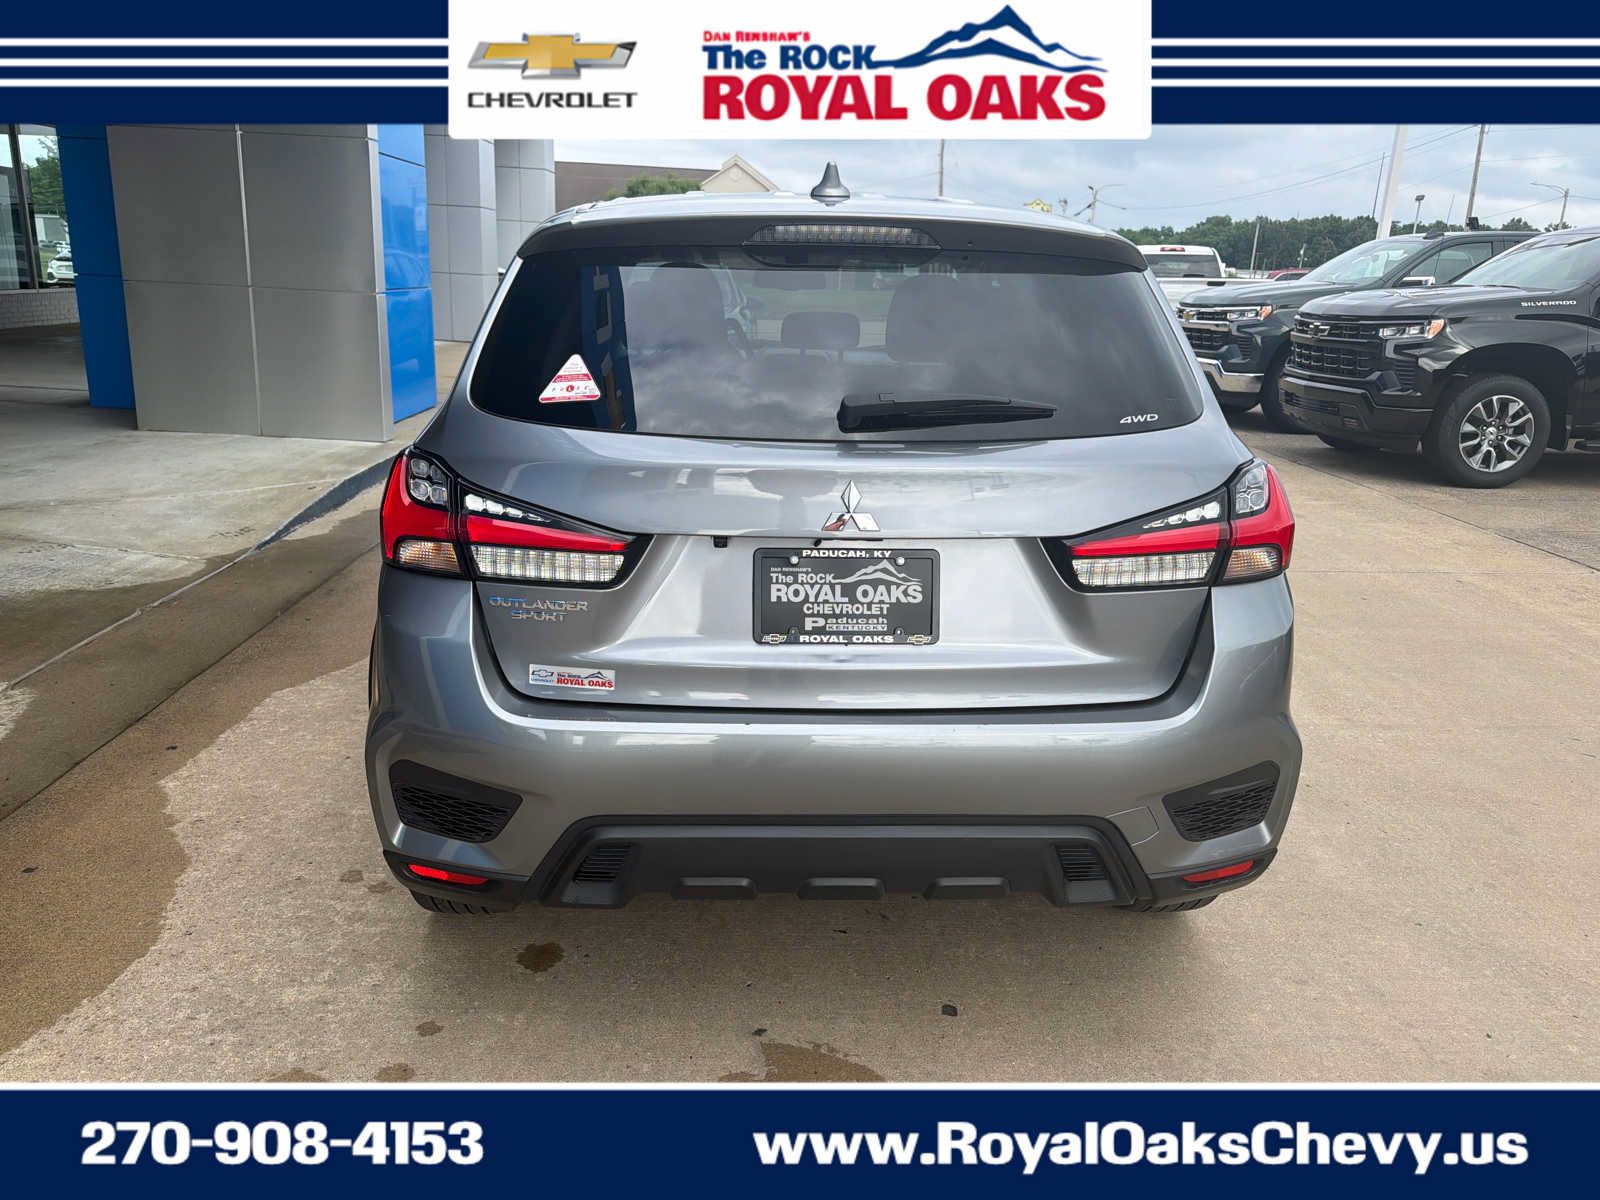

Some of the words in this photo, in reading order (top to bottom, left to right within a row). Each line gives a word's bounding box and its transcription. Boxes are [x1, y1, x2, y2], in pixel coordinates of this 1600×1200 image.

[1119, 413, 1159, 424] 4WD
[802, 550, 870, 559] PADUCAH,
[873, 550, 892, 558] KY
[770, 573, 794, 583] The
[798, 573, 835, 584] ROCK
[770, 584, 849, 603] ROYAL
[855, 584, 923, 604] OAKS
[488, 595, 589, 612] OUTLANDER
[803, 603, 890, 615] CHEVROLET
[511, 610, 569, 623] SPORT
[799, 635, 848, 643] ROYAL
[852, 635, 894, 643] OAKS
[556, 678, 585, 687] ROYAL
[588, 679, 614, 689] OAKS
